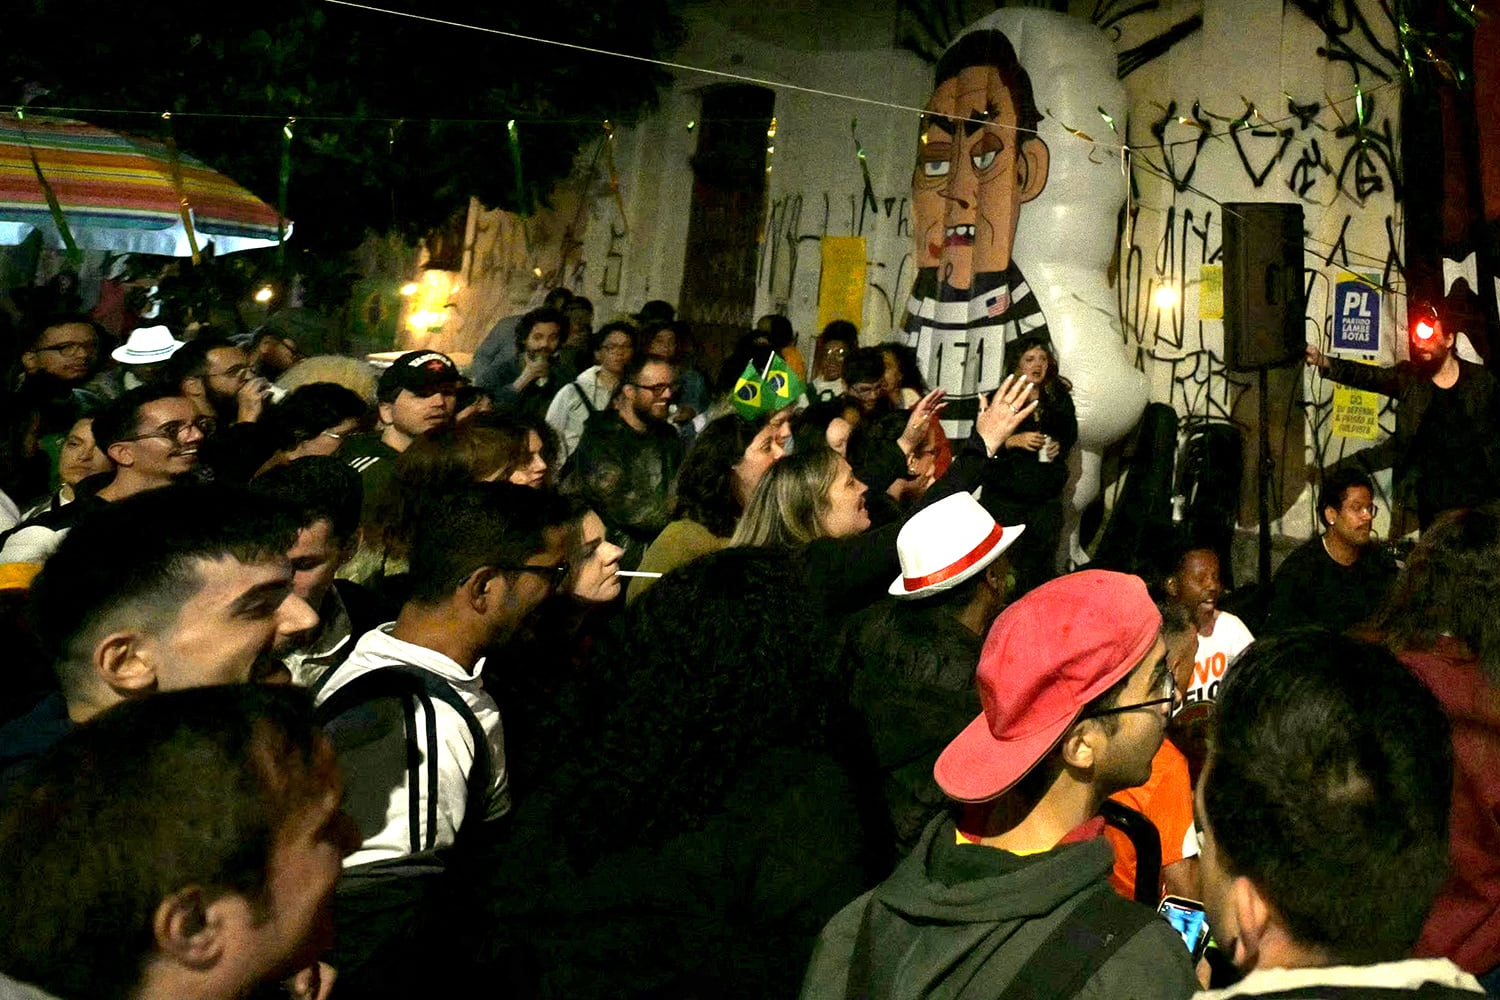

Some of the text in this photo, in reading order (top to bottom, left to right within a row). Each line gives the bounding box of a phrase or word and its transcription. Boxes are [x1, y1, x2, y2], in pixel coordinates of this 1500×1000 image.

[1343, 291, 1372, 317] PL
[1342, 317, 1371, 326] PARTIDO
[1342, 324, 1370, 333] LAMBE
[1342, 332, 1370, 342] BOTAS
